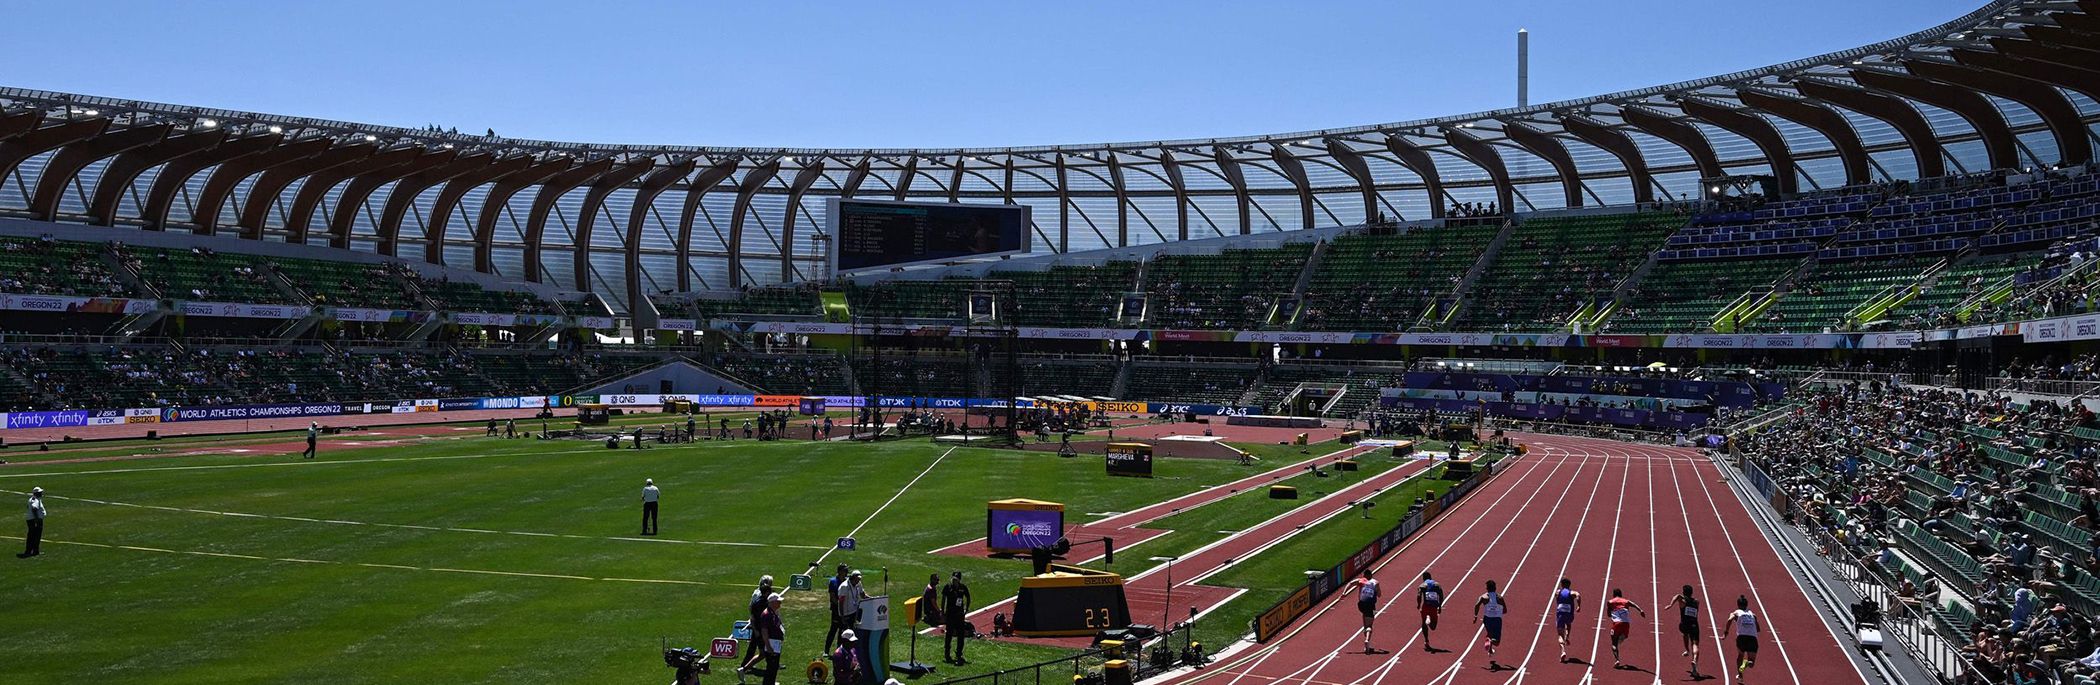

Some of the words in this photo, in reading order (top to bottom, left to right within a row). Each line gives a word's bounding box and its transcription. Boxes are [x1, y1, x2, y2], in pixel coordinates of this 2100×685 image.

[21, 301, 62, 309] OREGON22
[180, 306, 213, 314] OREGON22
[1703, 339, 1733, 347] OREGON22
[1766, 339, 1794, 347] OREGON22
[489, 397, 518, 408] MONDO
[701, 394, 724, 405] xfinity
[728, 395, 752, 405] xfinity
[941, 399, 961, 407] TDK
[180, 410, 206, 419] WORLD
[210, 408, 247, 418] ATHLETICS
[250, 406, 302, 416] CHAMPIONSHIPS
[305, 405, 341, 414] OREGON22
[1097, 402, 1139, 412] SEIKO
[11, 413, 46, 428] xfinity
[51, 411, 85, 427] xfinity
[129, 416, 156, 424] SEIKO
[796, 578, 803, 586] Q
[1084, 577, 1115, 585] SEIKO
[1085, 608, 1110, 628] 2.3
[1265, 606, 1283, 635] SEIKO
[715, 643, 733, 653] WR
